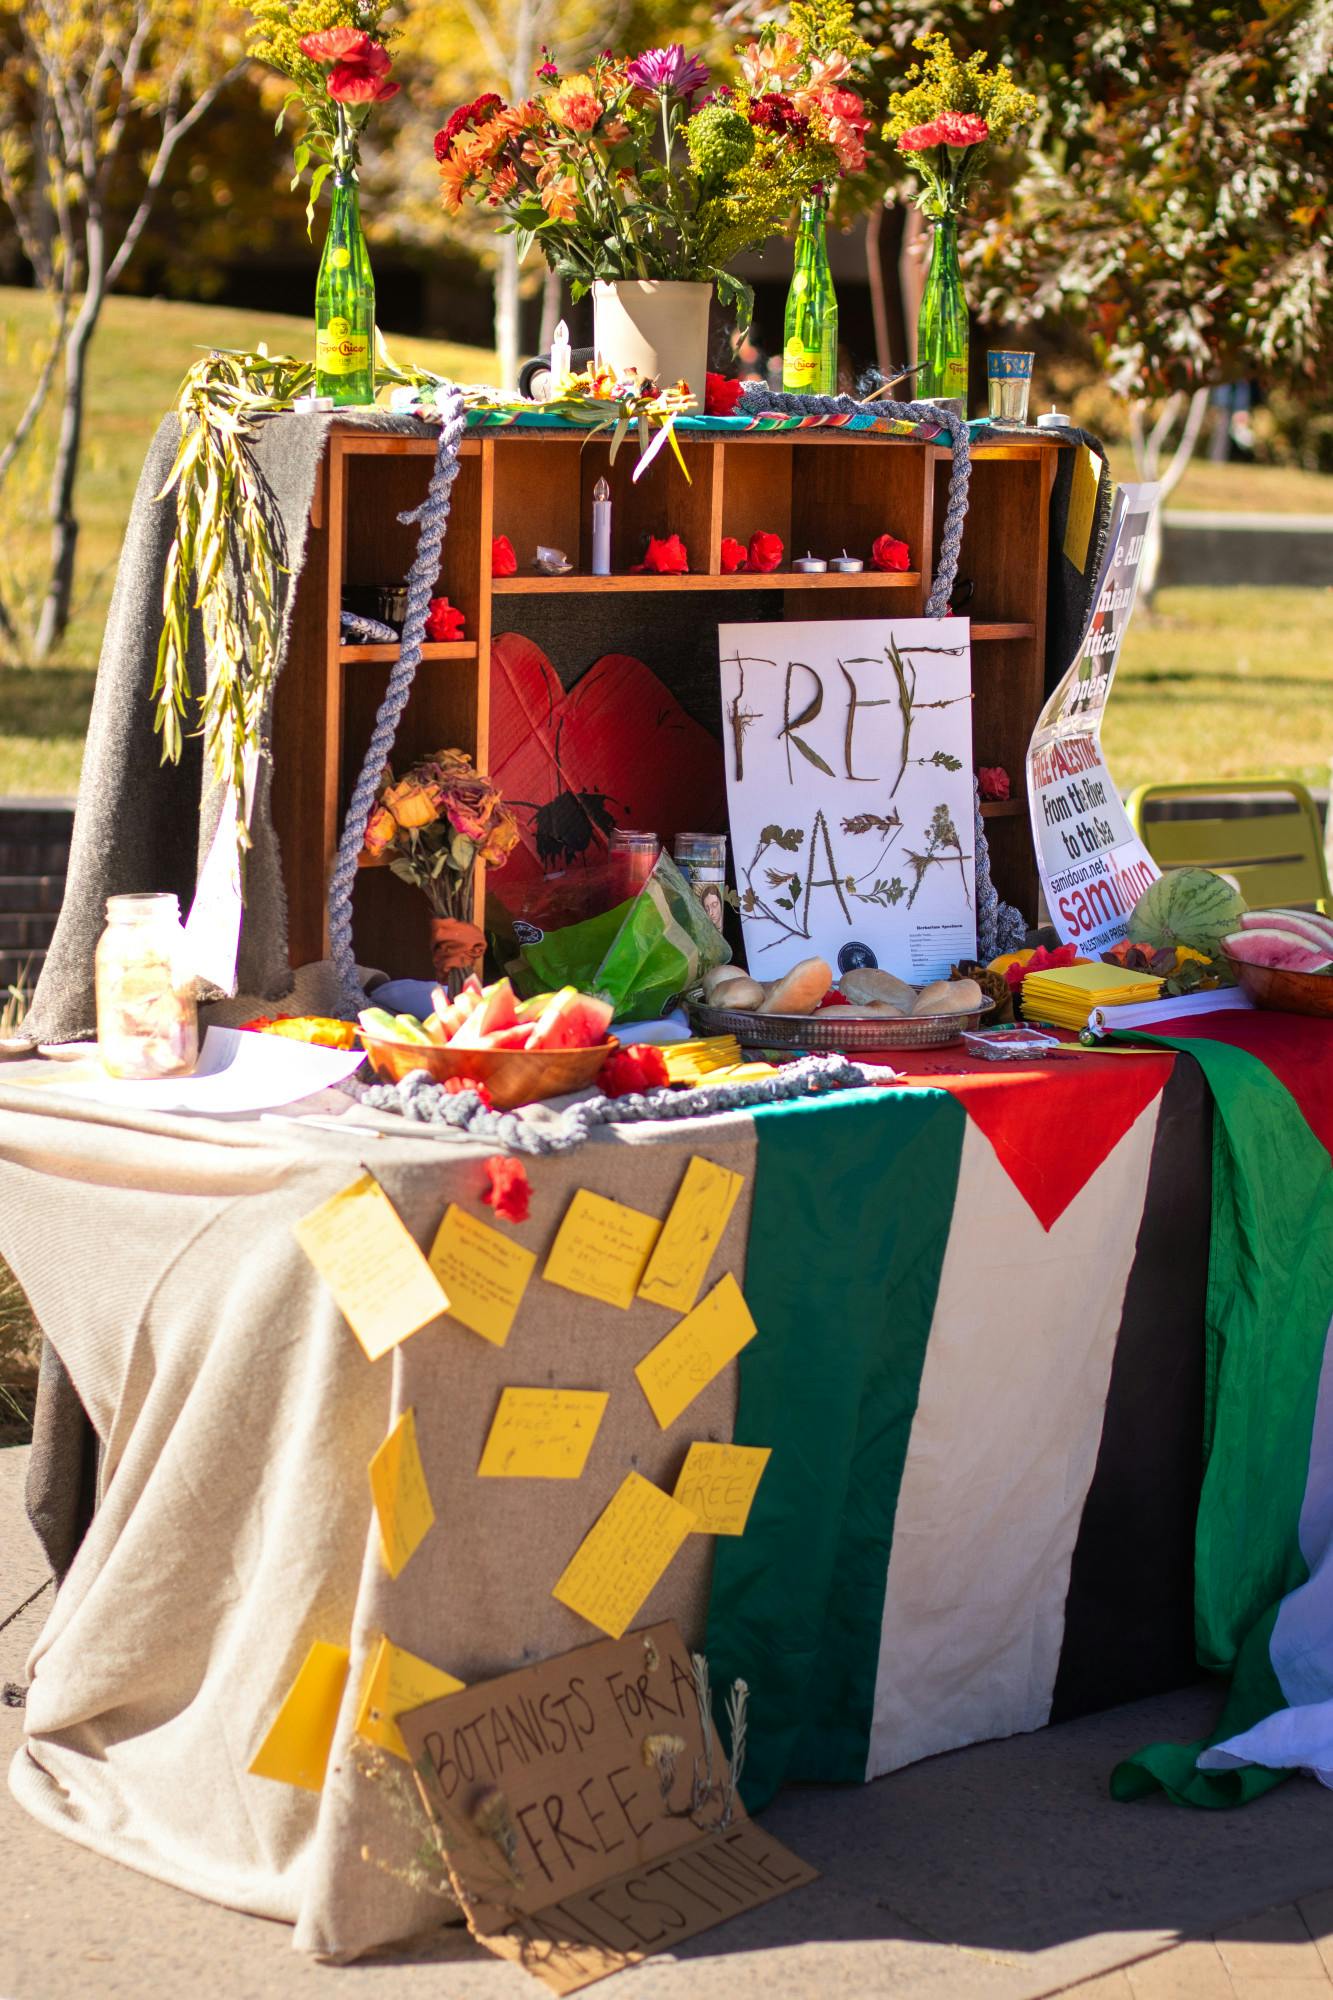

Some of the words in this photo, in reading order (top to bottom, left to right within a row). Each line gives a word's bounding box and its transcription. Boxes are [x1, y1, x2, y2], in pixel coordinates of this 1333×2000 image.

[339, 340, 366, 356] Chico
[1084, 622, 1122, 658] itical
[1068, 673, 1108, 703] oners
[720, 631, 975, 799] FREE
[1031, 747, 1053, 791] FREE
[1049, 731, 1101, 781] PALESTINE
[1042, 793, 1072, 827] From
[1066, 781, 1090, 815] the
[1081, 777, 1108, 810] River
[1061, 831, 1081, 860] to
[1075, 821, 1101, 853] the
[1092, 816, 1115, 848] Sea
[725, 803, 973, 953] GAZA
[1050, 857, 1107, 894] samidoun.net
[1058, 853, 1156, 937] samidoun
[1079, 931, 1112, 955] PALESTINIAN
[1108, 922, 1129, 941] PRISO
[423, 1677, 595, 1800] BOTANISTS
[606, 1671, 678, 1738] FOR
[670, 1655, 698, 1718] A
[517, 1766, 653, 1882] FREE
